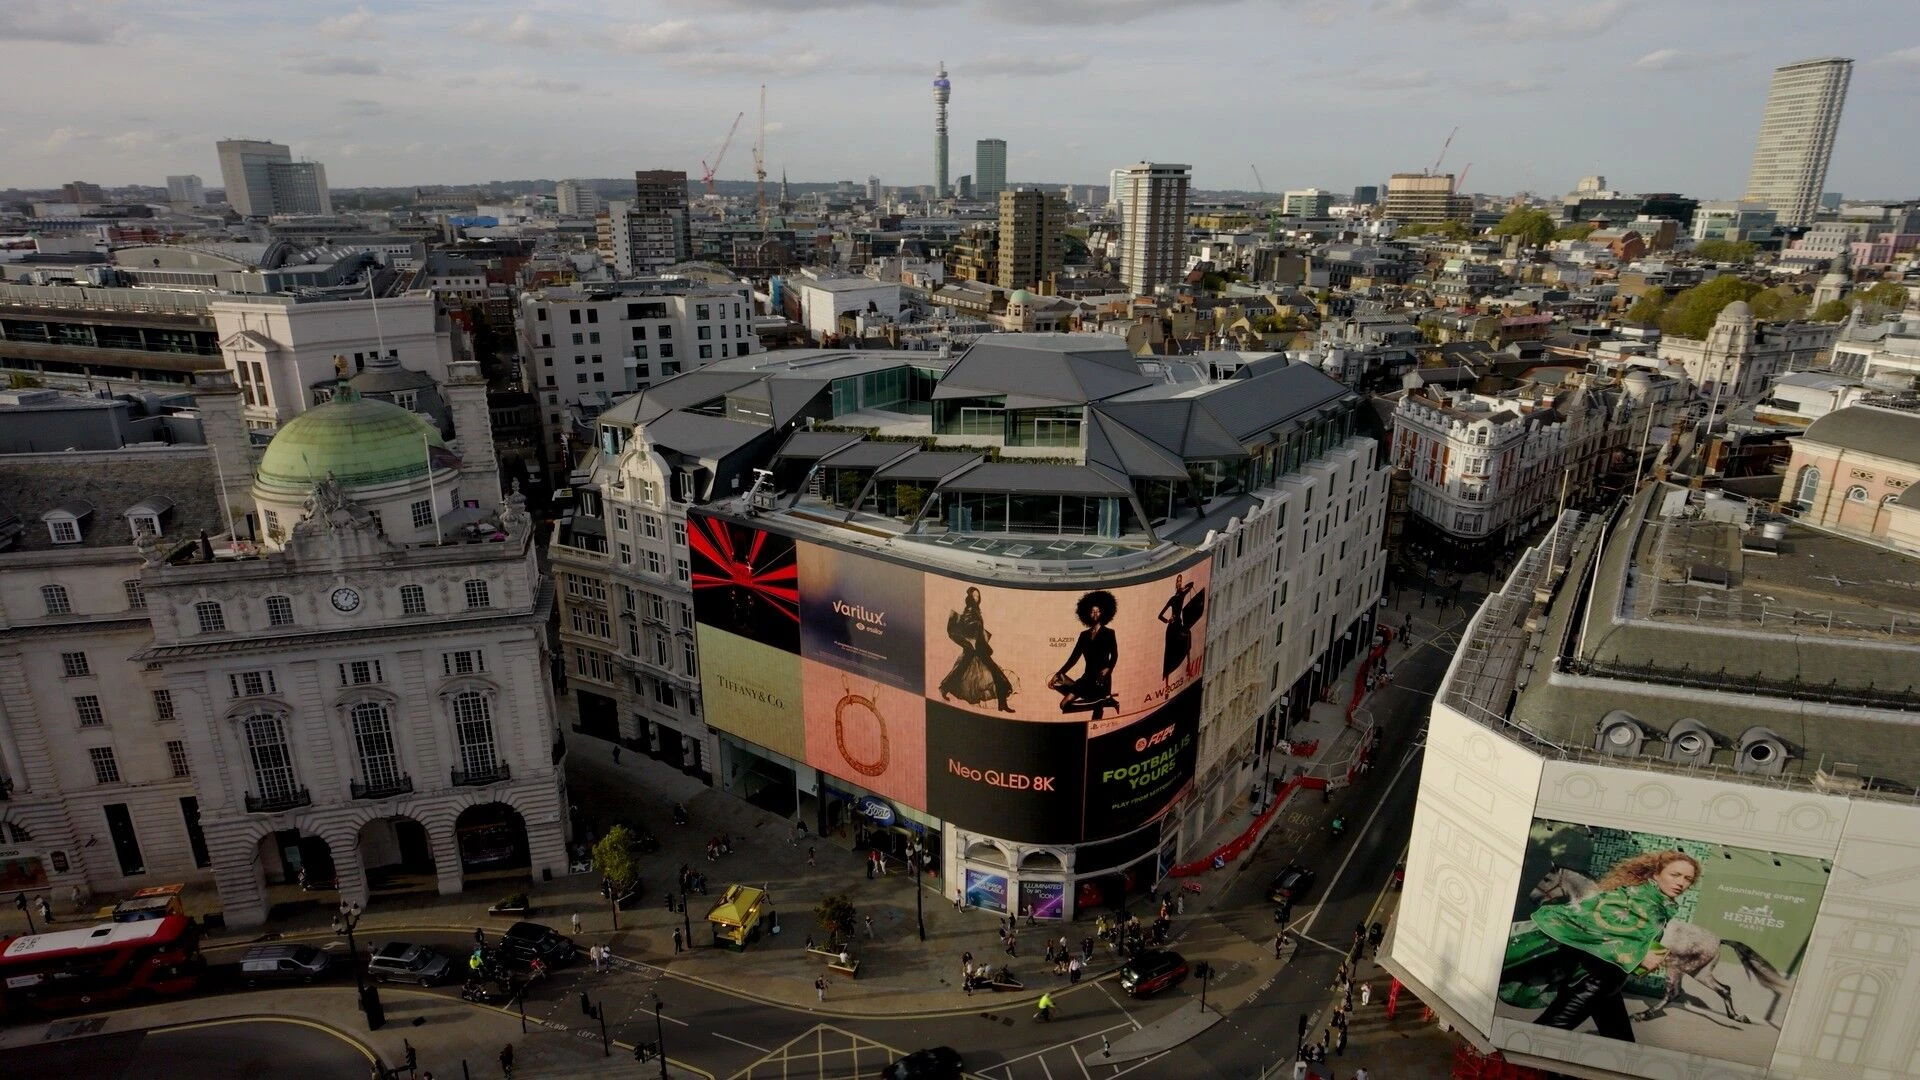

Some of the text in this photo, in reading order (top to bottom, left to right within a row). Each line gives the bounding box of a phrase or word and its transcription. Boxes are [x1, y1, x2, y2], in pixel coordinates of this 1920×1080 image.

[832, 599, 886, 626] Varilux
[717, 674, 757, 700] TIFFANY
[758, 691, 766, 703] &
[1103, 743, 1179, 783] FOOTBALL
[1181, 733, 1191, 749] IS
[949, 758, 1056, 791] Neo QLED 8K
[1128, 757, 1177, 790] YOURS
[1112, 800, 1130, 810] PLAY
[1023, 882, 1062, 890] ILLUMINATED
[1717, 884, 1806, 904] Astonishing orange
